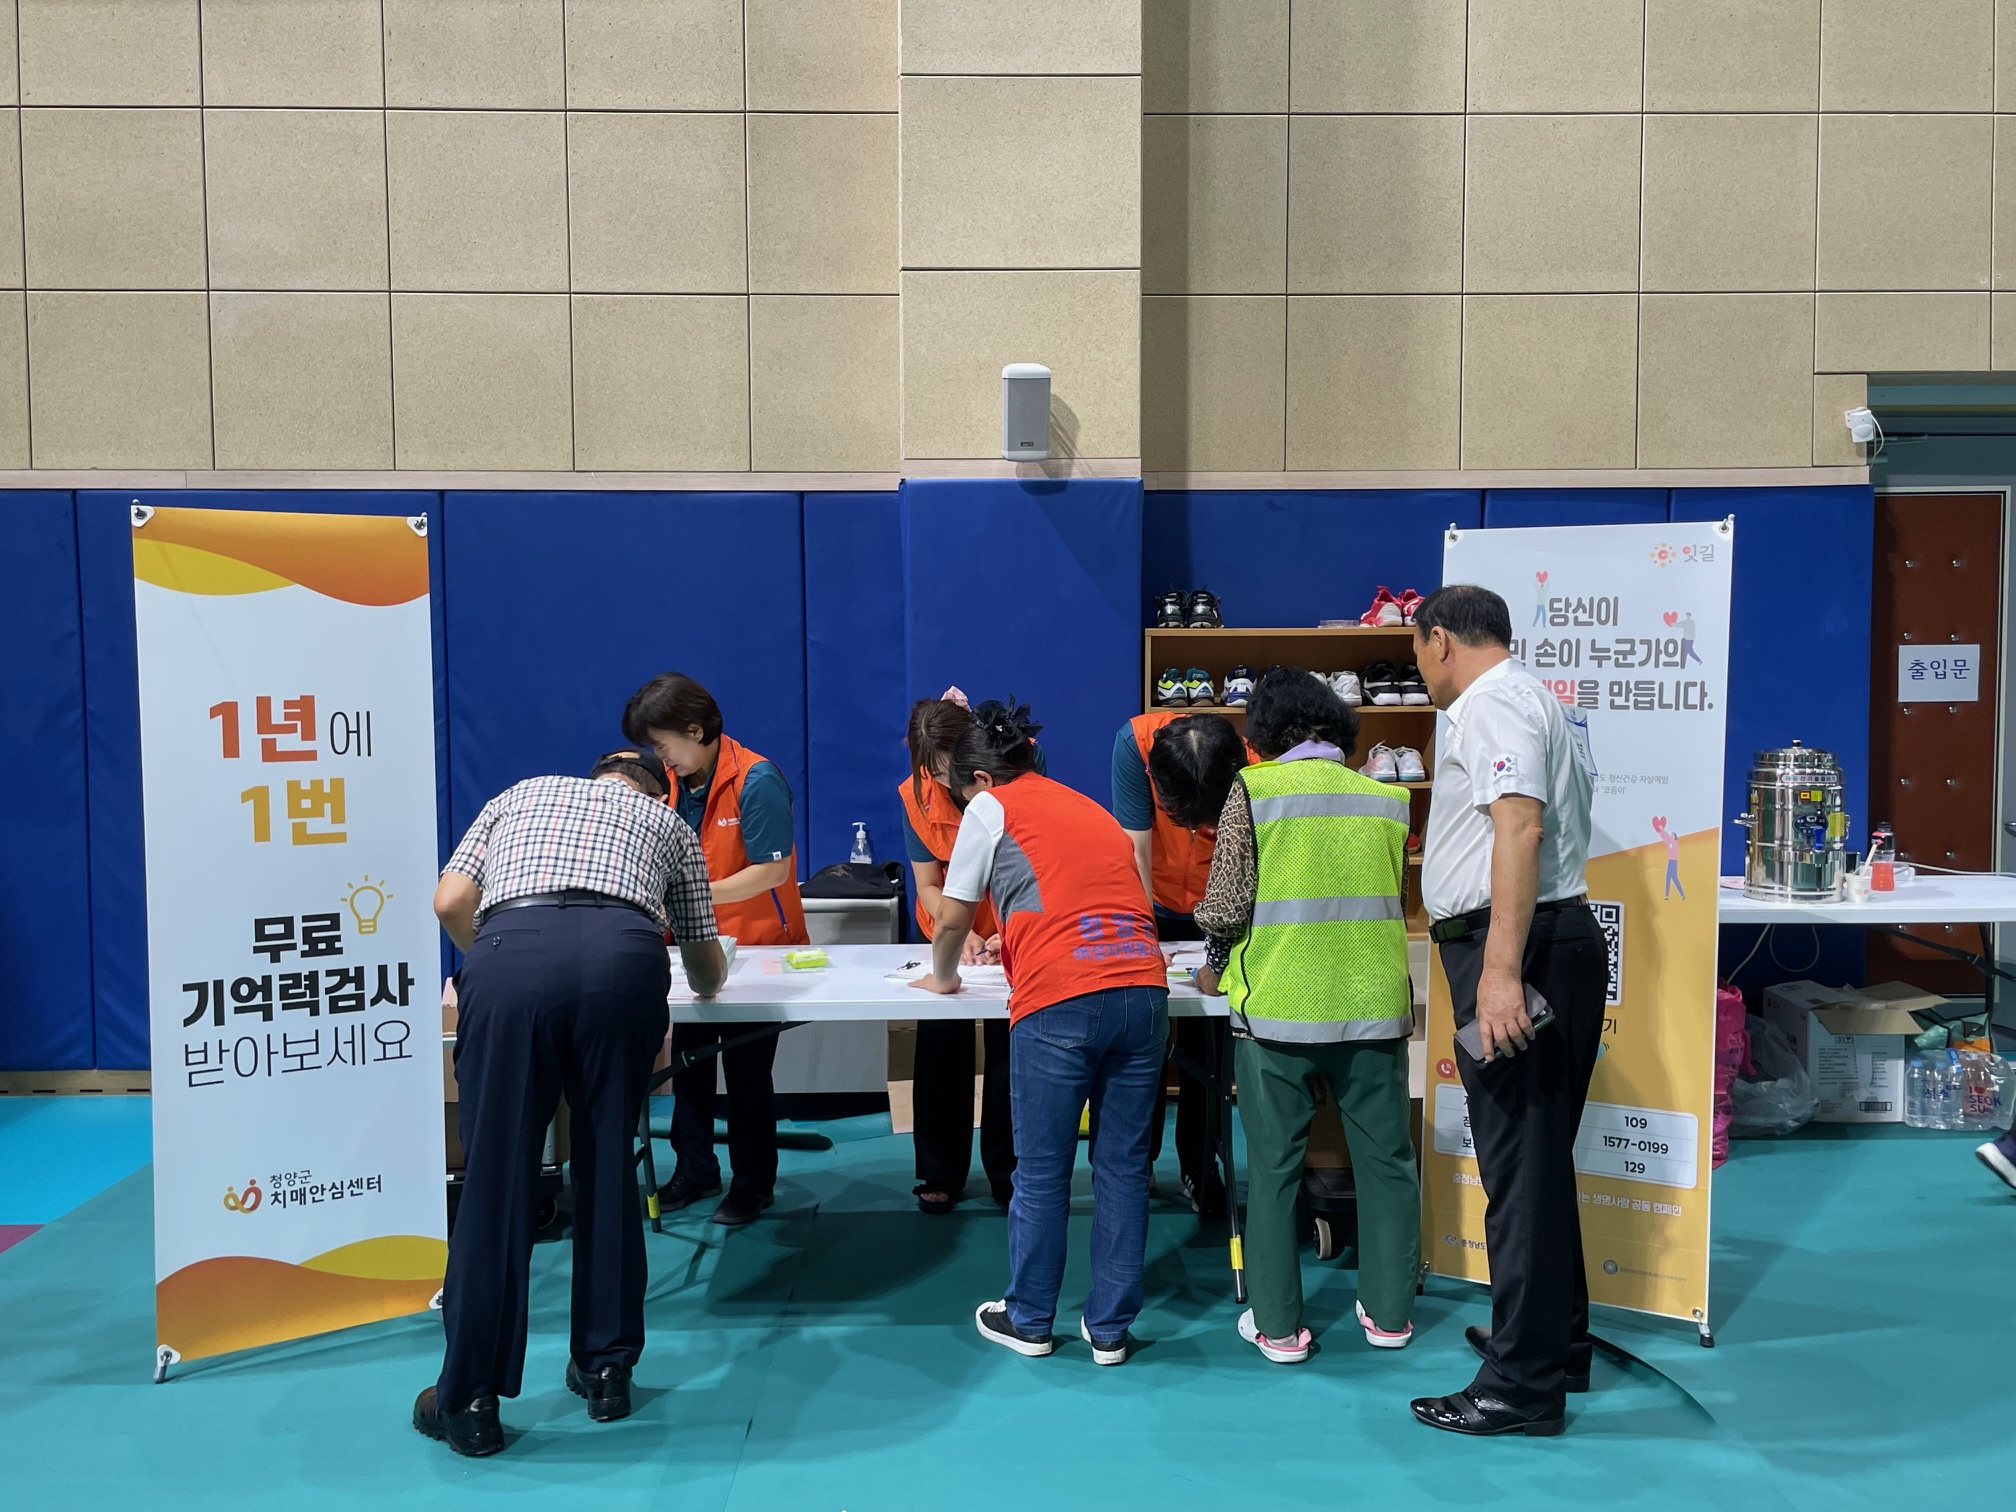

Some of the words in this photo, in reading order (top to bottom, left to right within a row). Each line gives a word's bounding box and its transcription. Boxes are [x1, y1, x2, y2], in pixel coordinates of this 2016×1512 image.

[1549, 596, 1619, 627] 당신이
[1535, 638, 1581, 668] 손이
[1589, 638, 1687, 669] 누군가의
[1907, 659, 1971, 680] 출입문
[1609, 680, 1714, 712] 만듭니다.
[209, 695, 373, 763] 1년에
[1609, 774, 1637, 783] 정신건강
[240, 777, 348, 846] 1번
[252, 912, 344, 963] 무료
[182, 962, 415, 1028] 기억력검사
[184, 1019, 413, 1088] 받아보세요
[1624, 1116, 1647, 1129] 109
[1603, 1135, 1669, 1154] 1577-0199
[270, 1170, 313, 1189] 청양군
[1624, 1160, 1646, 1174] 129
[270, 1174, 382, 1209] 치매안심센터
[1654, 1202, 1682, 1216] 캠페인
